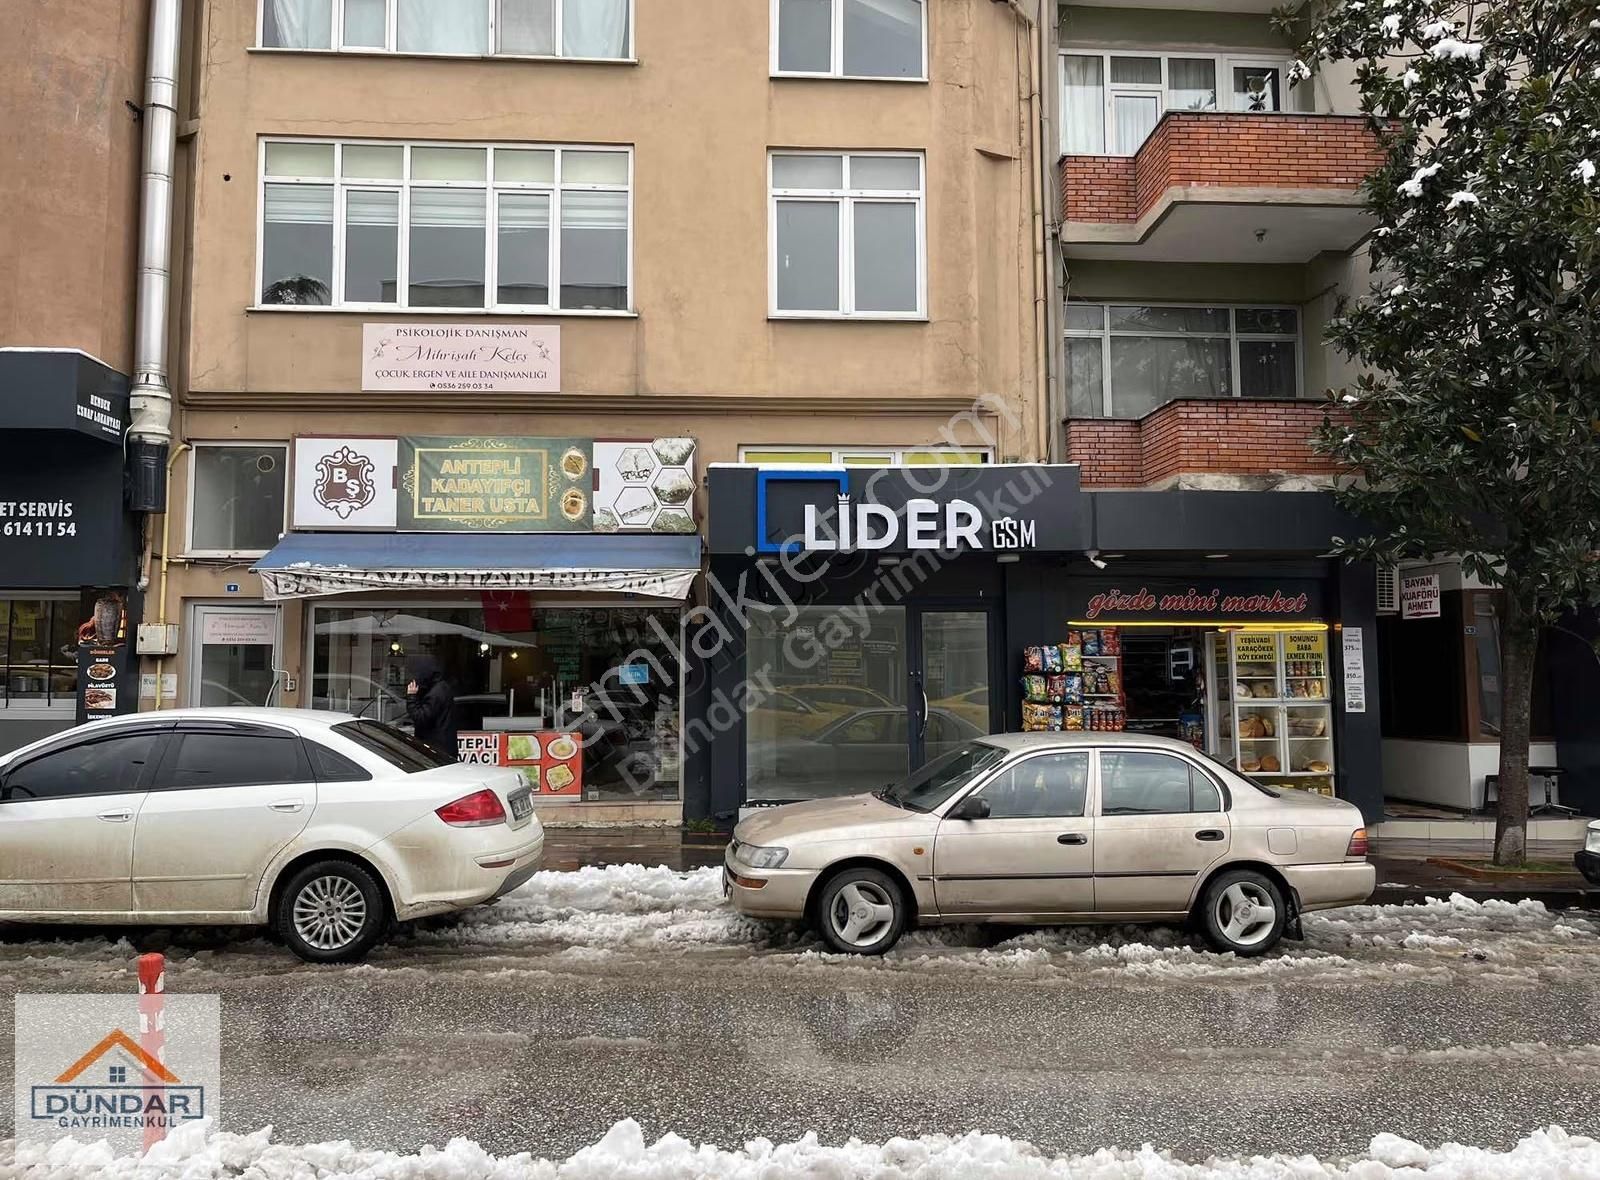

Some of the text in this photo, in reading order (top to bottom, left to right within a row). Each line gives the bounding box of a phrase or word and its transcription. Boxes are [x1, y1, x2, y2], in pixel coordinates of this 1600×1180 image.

[396, 327, 528, 340] PSİKOLOJİK DANIŞMAN
[412, 370, 443, 378] ERGEN
[445, 370, 458, 378] VE
[479, 370, 548, 381] DANIŞMANLIĞI
[439, 456, 522, 474] ANTEPLİ
[431, 478, 531, 498] KADAYIFÇI
[18, 499, 73, 518] SERVİS
[421, 498, 540, 514] TANER USTA
[3, 521, 77, 537] 614 11 54
[991, 517, 1037, 550] GSM
[1404, 576, 1433, 589] BAYAN
[1401, 586, 1439, 601] KUAFÖRÜ
[1086, 588, 1308, 619] gözde mini market
[1407, 600, 1433, 612] AHMET
[1289, 635, 1318, 643] SOMUNCU
[1286, 652, 1306, 660] EKMEK
[458, 735, 498, 749] TEPLİ
[458, 752, 498, 764] VACI
